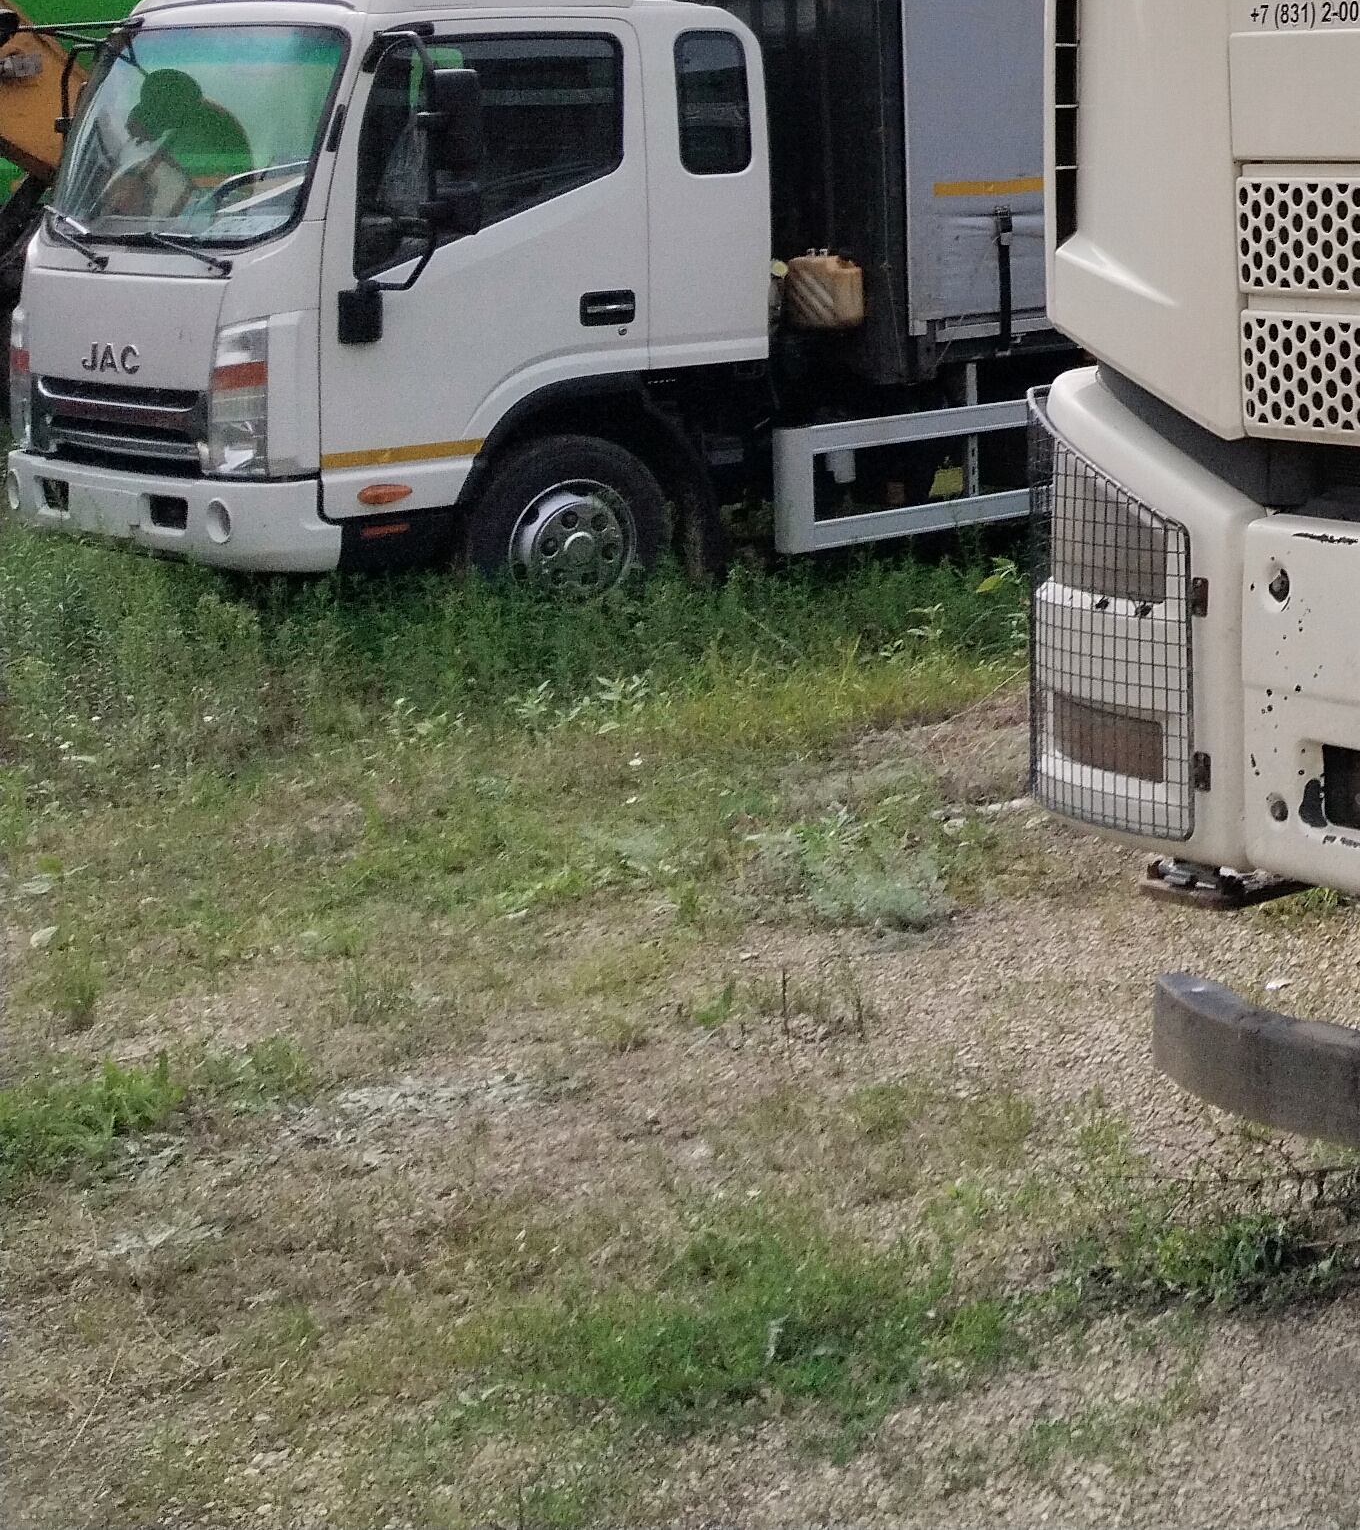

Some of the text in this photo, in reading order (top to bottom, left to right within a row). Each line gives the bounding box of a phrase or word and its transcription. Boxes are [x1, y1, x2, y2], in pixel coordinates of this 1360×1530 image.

[1250, 4, 1269, 24] +7
[1274, 2, 1316, 29] (831)
[81, 341, 141, 375] JAC
